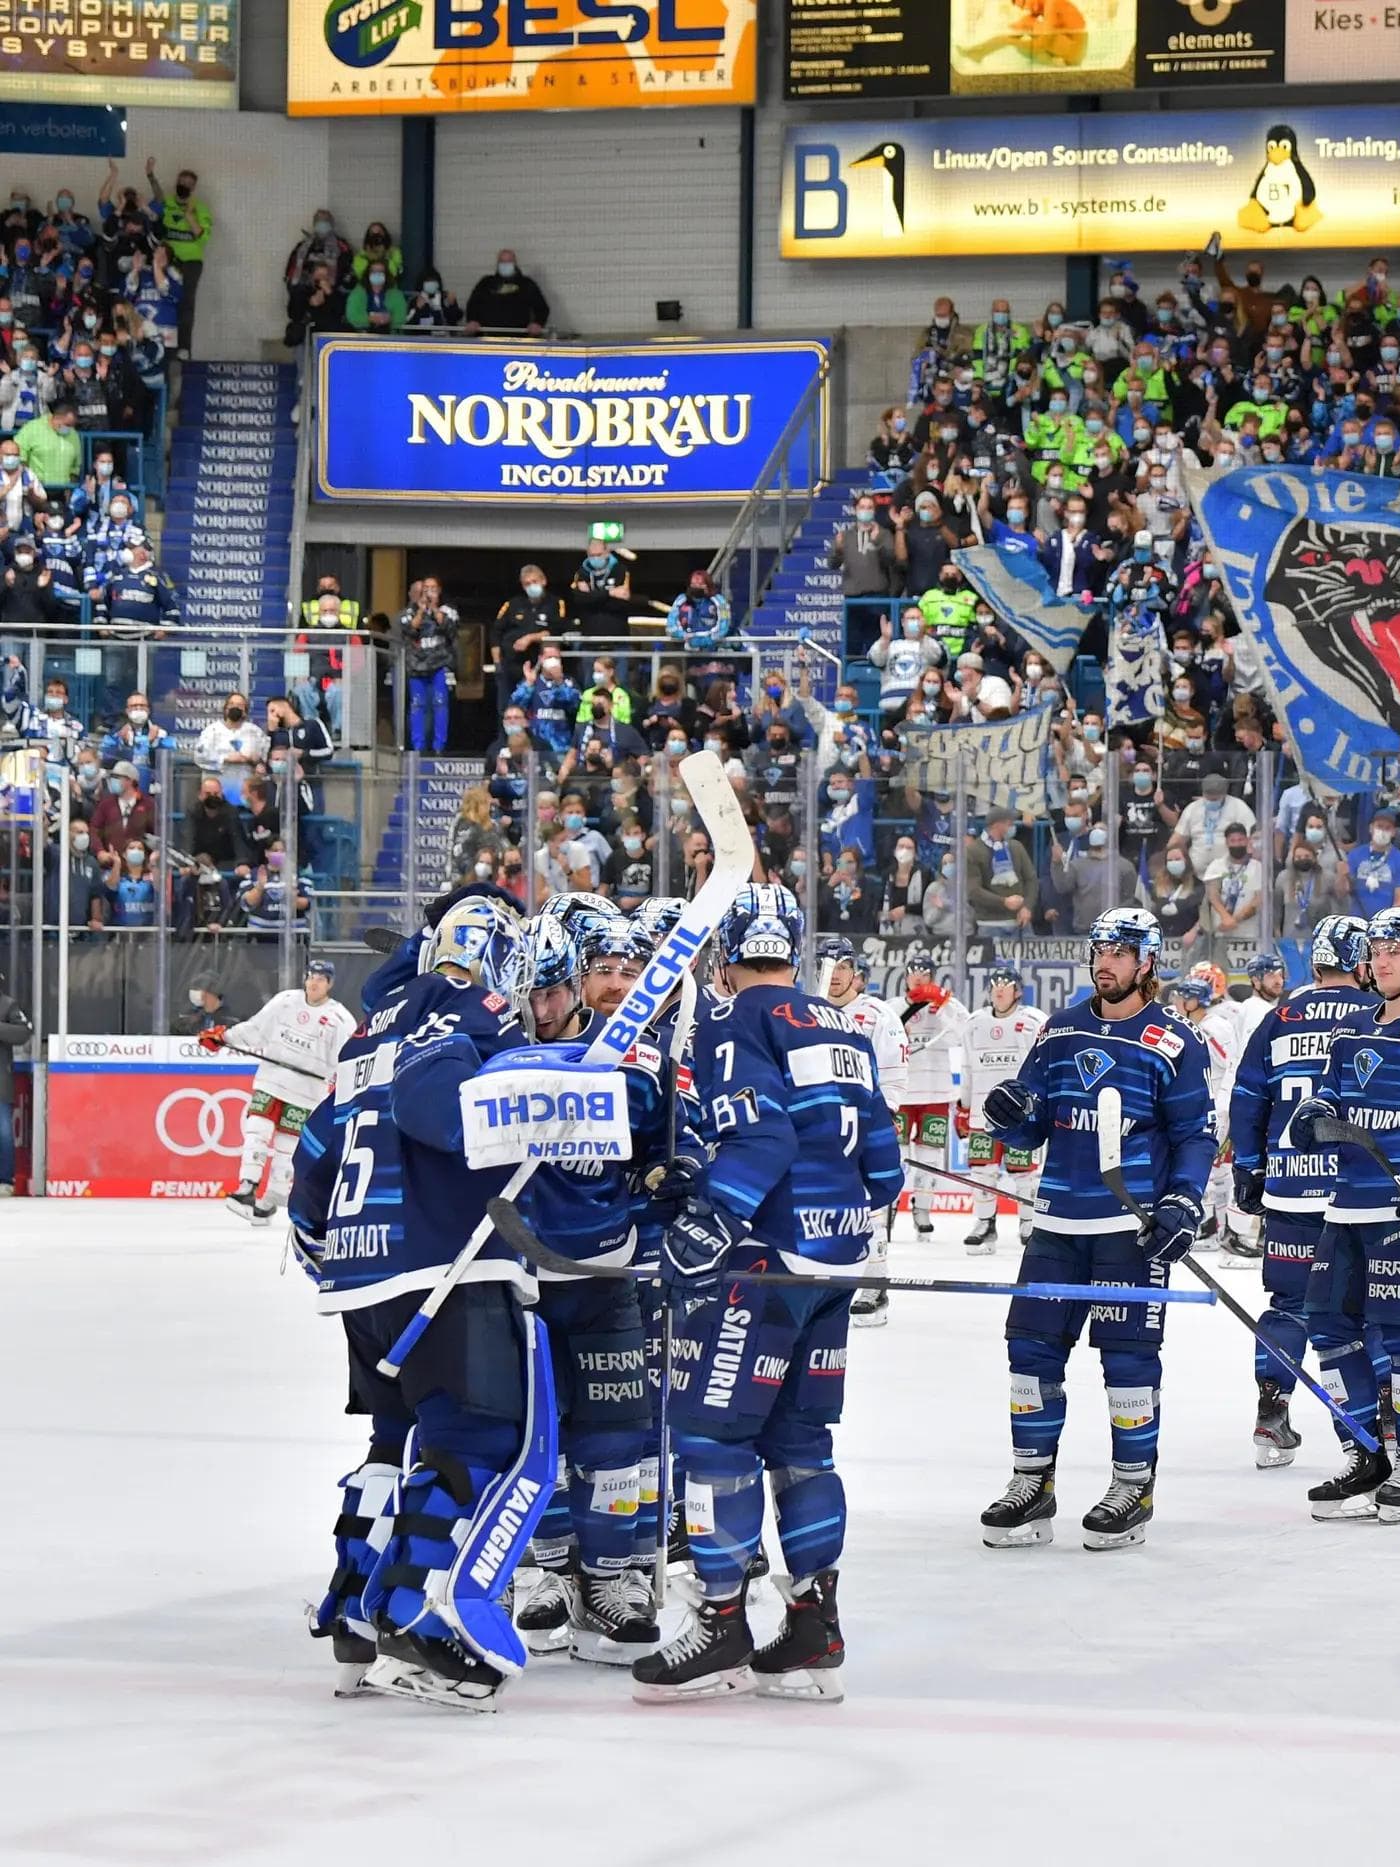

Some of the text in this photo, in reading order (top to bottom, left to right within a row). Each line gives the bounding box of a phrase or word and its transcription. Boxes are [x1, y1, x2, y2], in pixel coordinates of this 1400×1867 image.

[371, 7, 410, 44] LIFT
[434, 0, 725, 49] BESL
[1314, 10, 1363, 31] Kies
[2, 36, 217, 62] SYSTEME
[1167, 30, 1253, 50] elements
[331, 68, 727, 94] ARBEITSBÜHNEN & STAPLER
[933, 142, 1234, 171] Linux/Open Source Consulting,
[503, 360, 670, 393] Privatbrauerei
[407, 392, 752, 460] NORDBRÄU
[500, 464, 669, 488] INGOLSTADT
[602, 926, 709, 1053] BÜCHL
[109, 1043, 153, 1057] Audi
[715, 1041, 735, 1082] 7
[474, 1092, 615, 1128] BÜCHL
[527, 1141, 621, 1158] VAUGHN
[1267, 1239, 1316, 1260] CINQUE
[1090, 1305, 1128, 1323] BRÄU
[579, 1349, 644, 1372] HERRN
[703, 1306, 751, 1409] SATURN
[588, 1380, 644, 1402] BRÄU
[469, 1477, 542, 1591] VAUGHN
